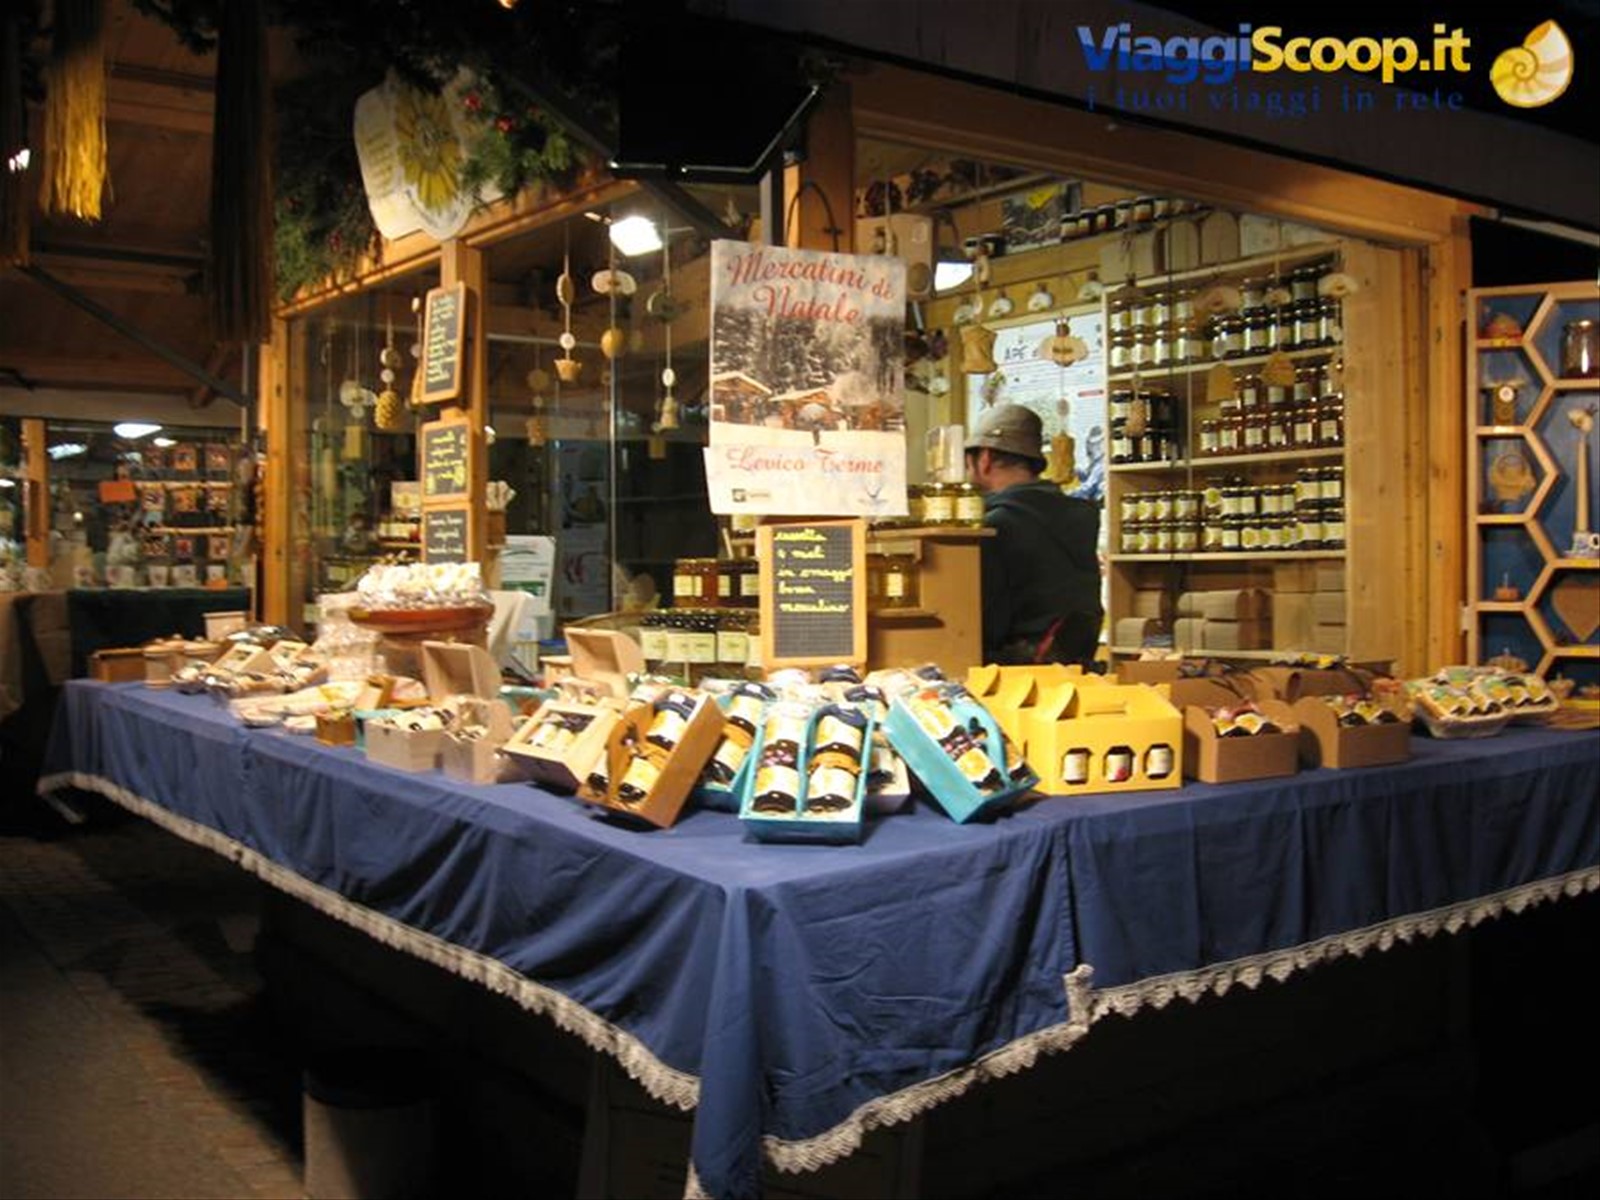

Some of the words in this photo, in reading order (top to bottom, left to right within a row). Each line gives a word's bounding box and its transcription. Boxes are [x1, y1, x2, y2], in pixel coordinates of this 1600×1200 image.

[727, 251, 867, 289] Mercatini
[872, 276, 895, 301] di
[752, 284, 862, 325] Natale
[813, 447, 883, 475] Terme
